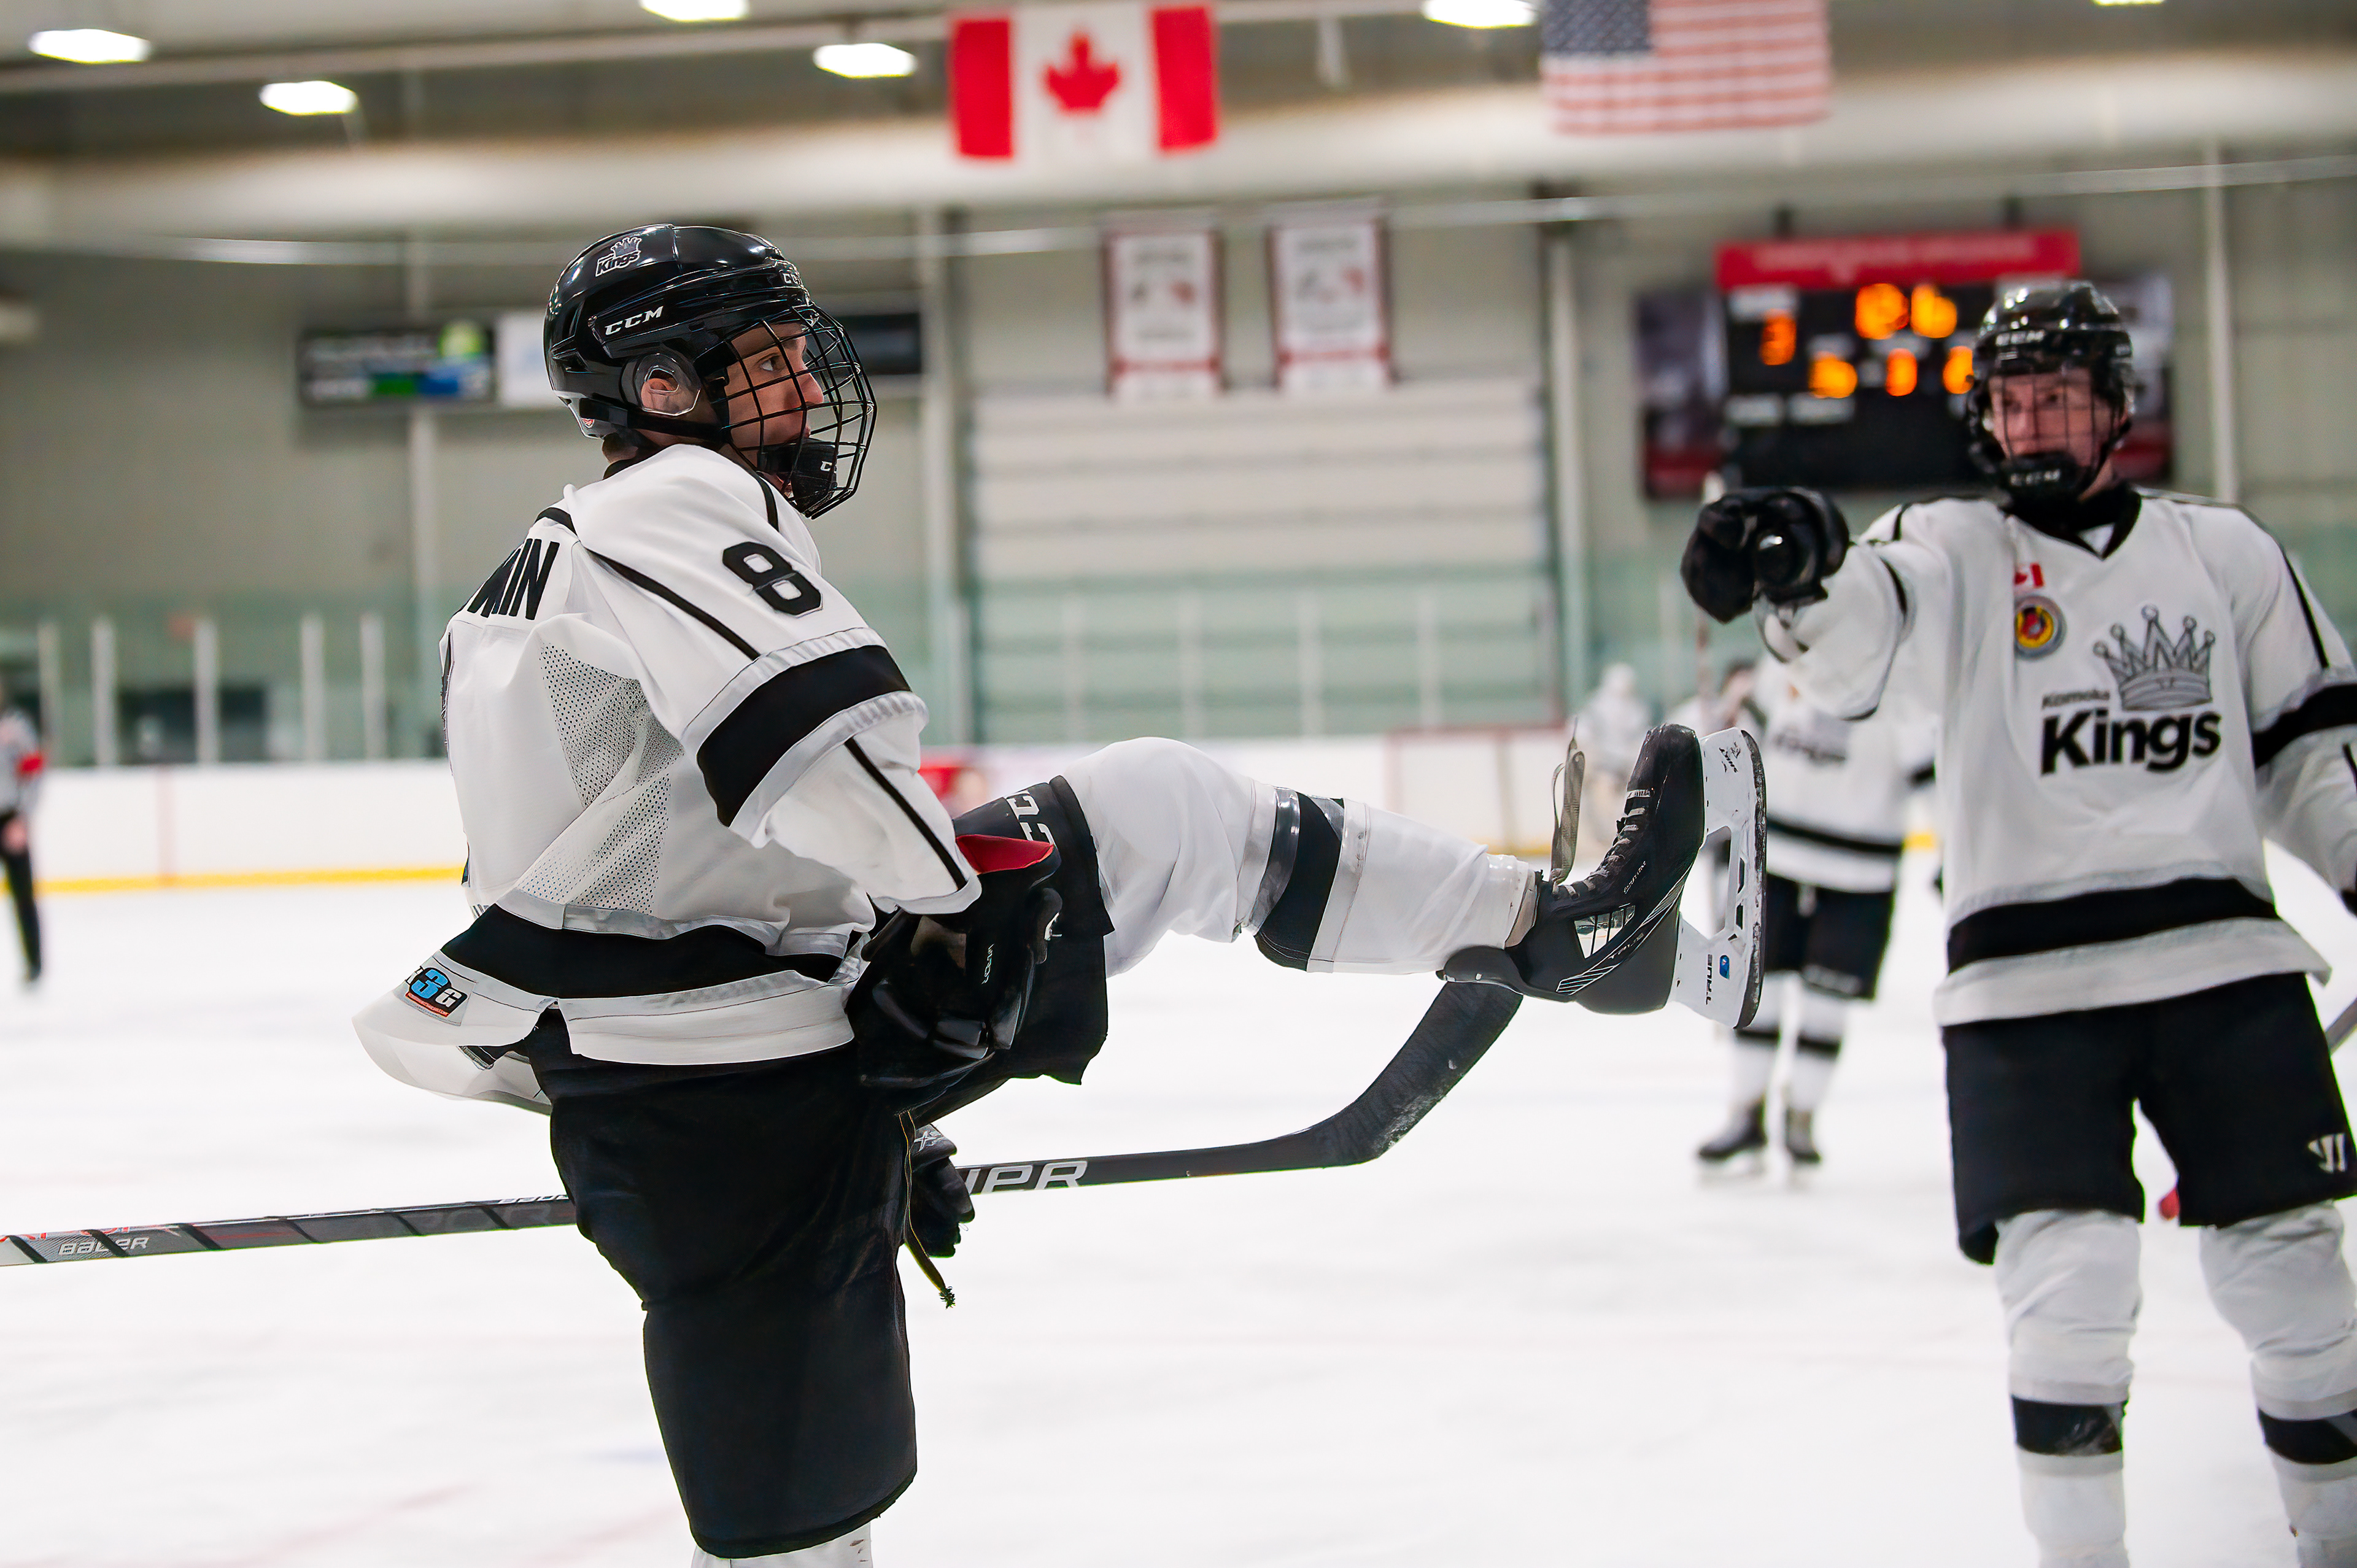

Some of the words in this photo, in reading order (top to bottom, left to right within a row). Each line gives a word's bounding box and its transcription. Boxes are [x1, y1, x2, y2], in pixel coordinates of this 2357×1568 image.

[605, 306, 664, 335] CCM
[722, 541, 824, 616] 8
[2040, 708, 2222, 777] Kings
